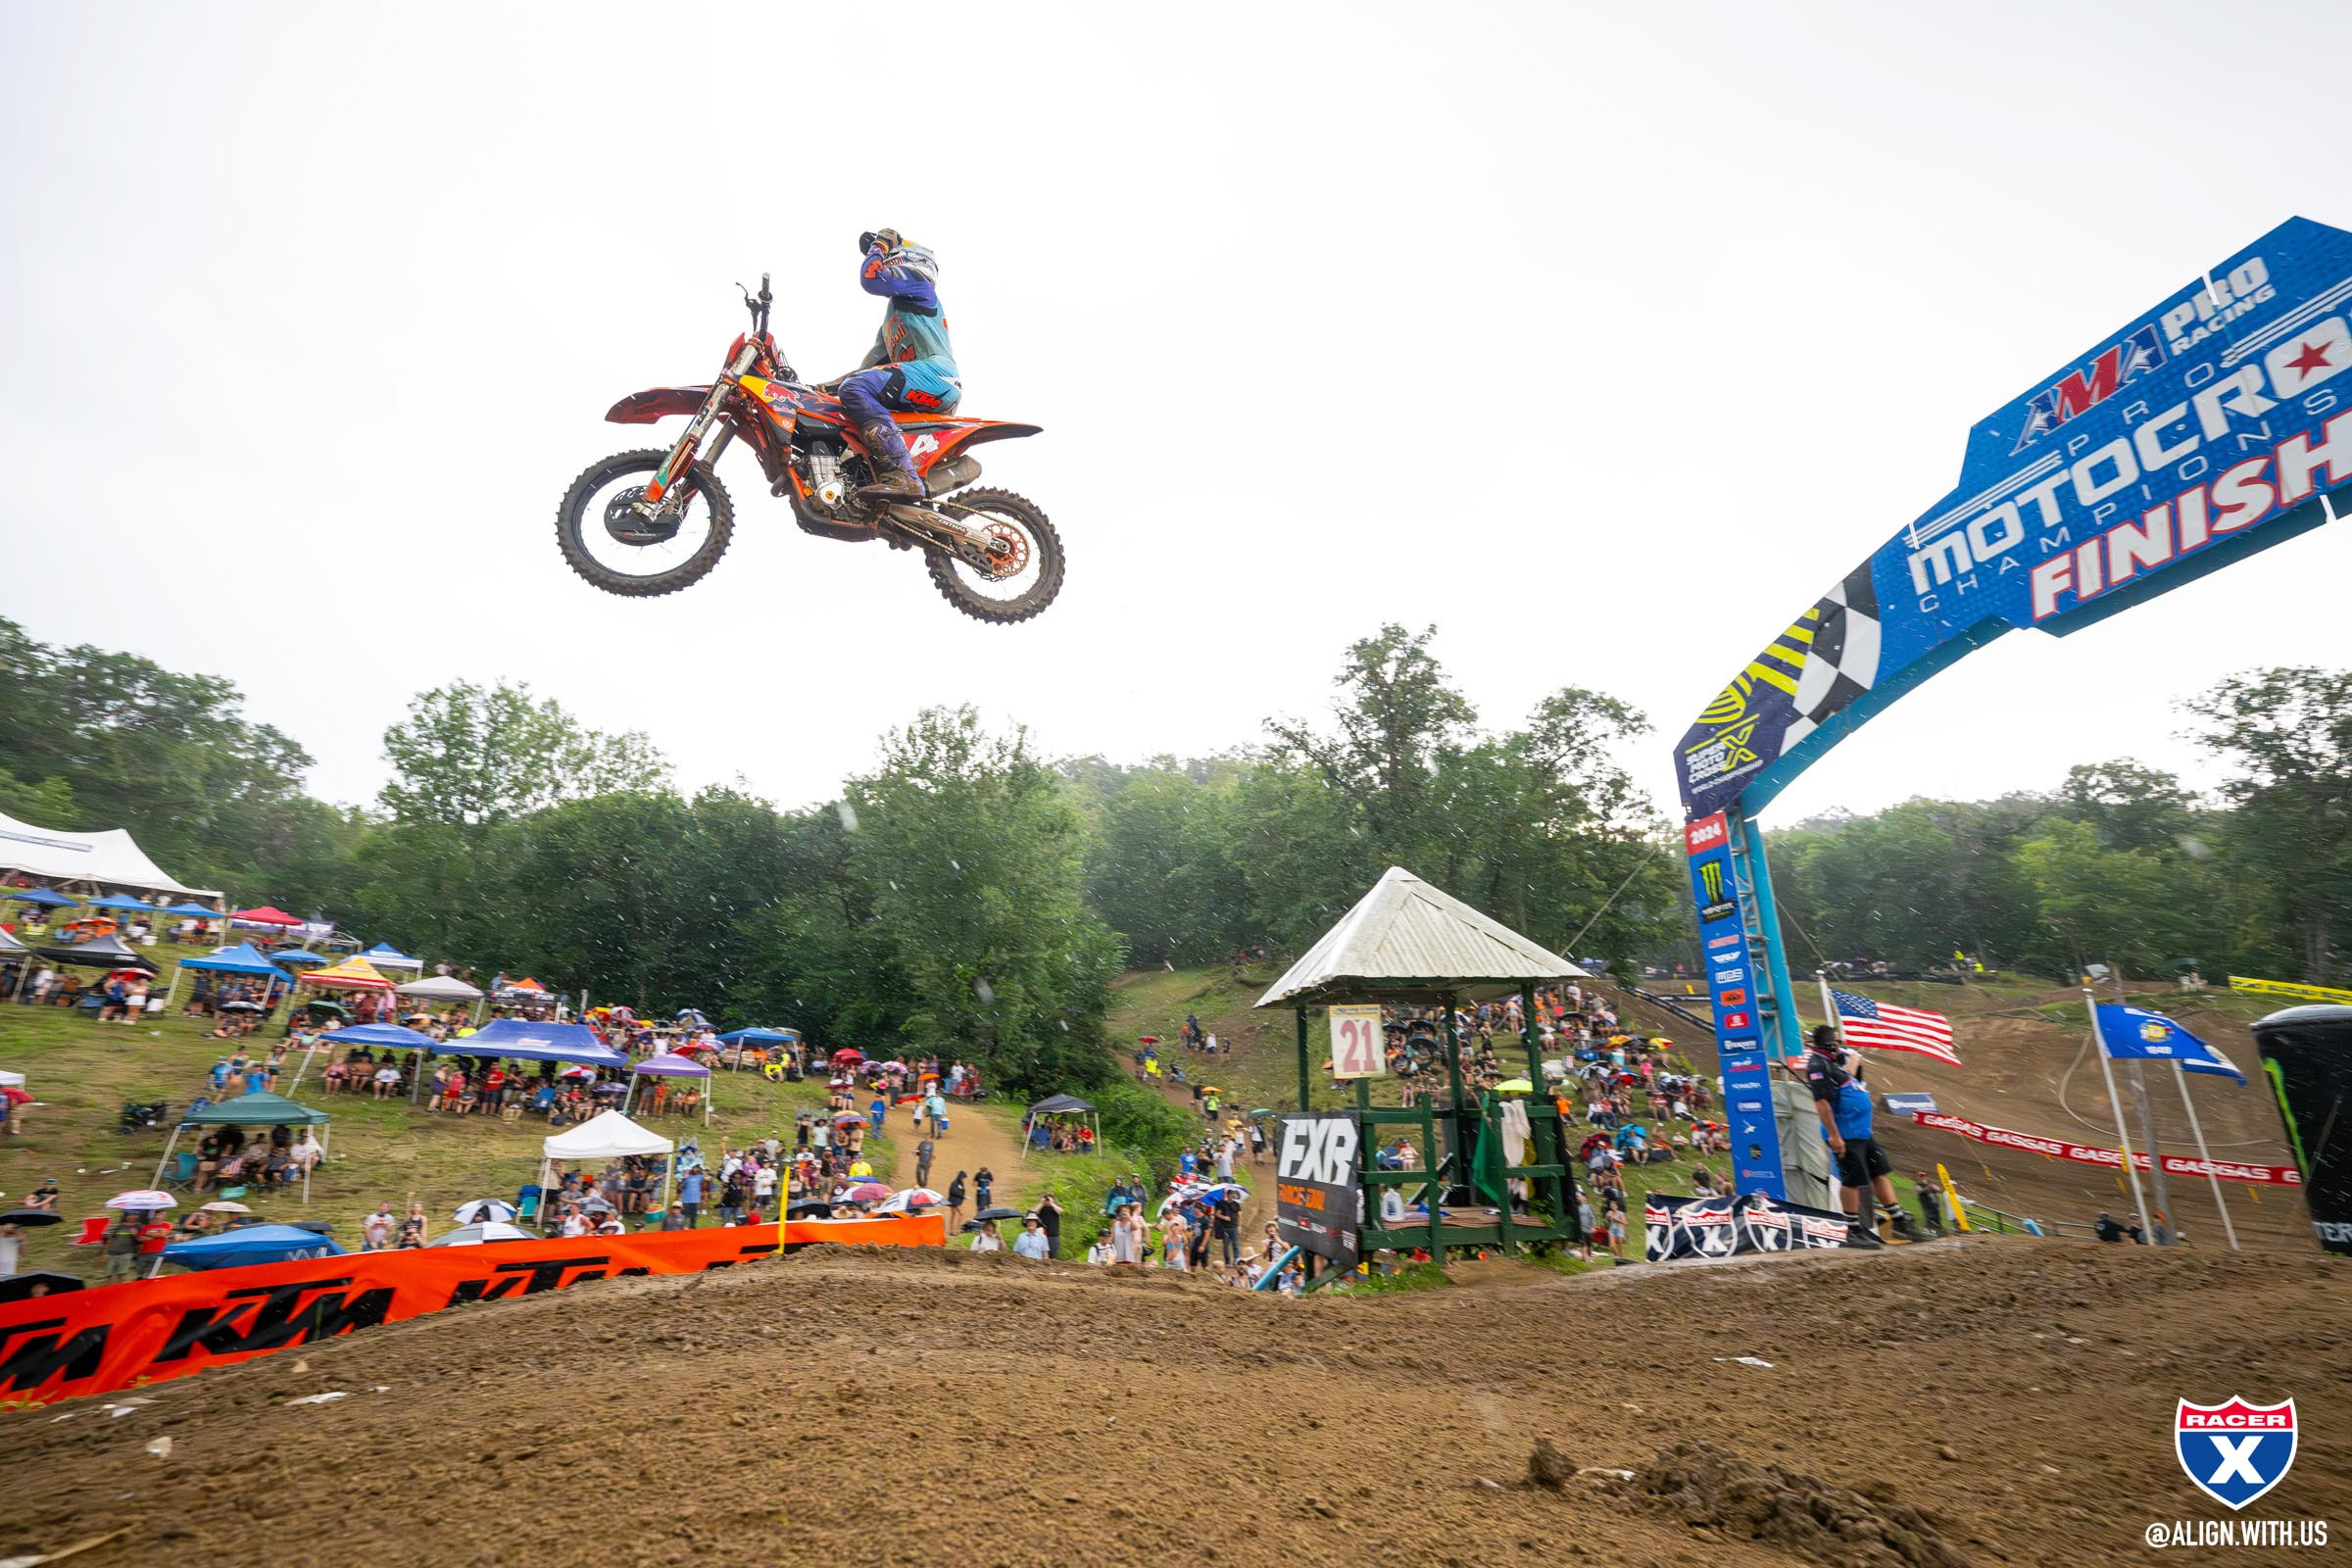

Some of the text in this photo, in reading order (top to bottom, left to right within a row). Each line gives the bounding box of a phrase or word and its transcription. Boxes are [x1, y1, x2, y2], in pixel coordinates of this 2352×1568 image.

[2160, 257, 2269, 341] PRO
[2170, 283, 2277, 356] RACING
[904, 389, 942, 409] KTM
[2008, 323, 2168, 457] AMA
[908, 434, 940, 458] 4
[1907, 316, 2352, 596] MOTOCRO
[2030, 408, 2352, 621] FINISH
[1690, 821, 1723, 845] 2024
[1340, 1019, 1377, 1073] 21
[1277, 1118, 1359, 1187] FXR
[1986, 1130, 2063, 1155] GASGAS
[2166, 1158, 2272, 1181] GASGAS
[151, 1276, 396, 1364] KTM
